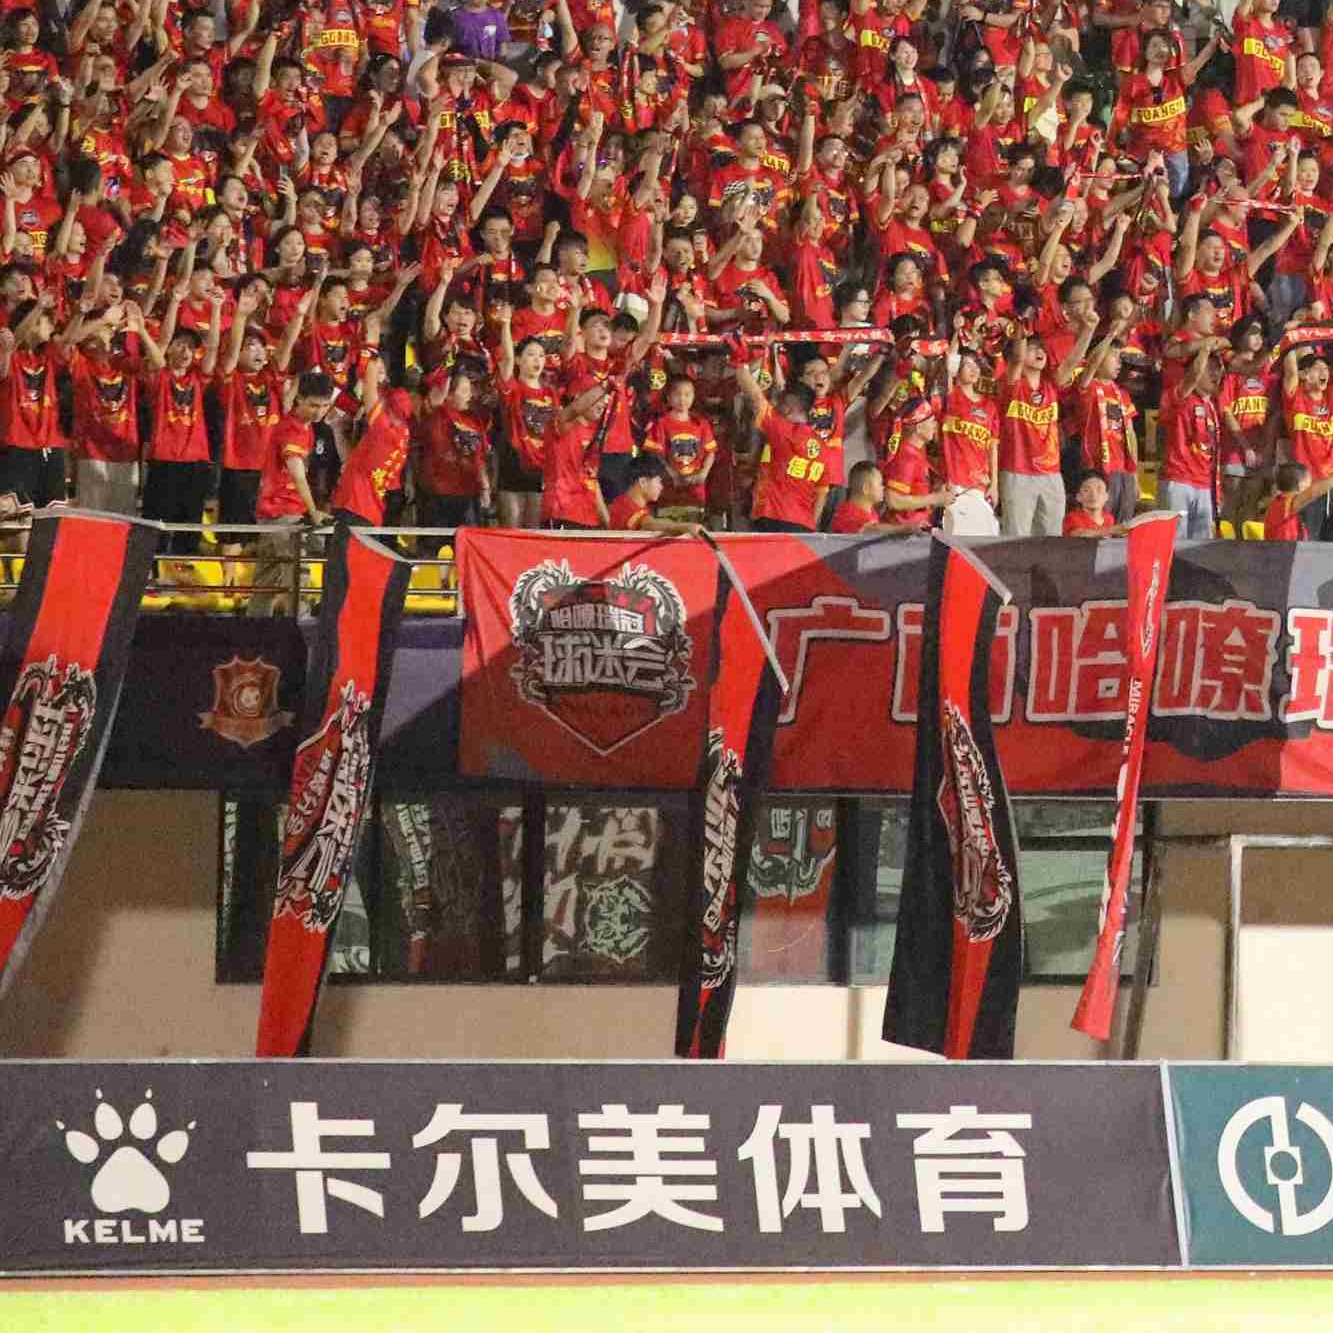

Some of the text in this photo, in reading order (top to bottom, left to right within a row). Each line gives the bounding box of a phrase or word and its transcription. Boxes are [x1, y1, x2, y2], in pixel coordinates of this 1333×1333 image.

[247, 1100, 1031, 1235] 卡尔美体育
[64, 1218, 205, 1244] KELME
